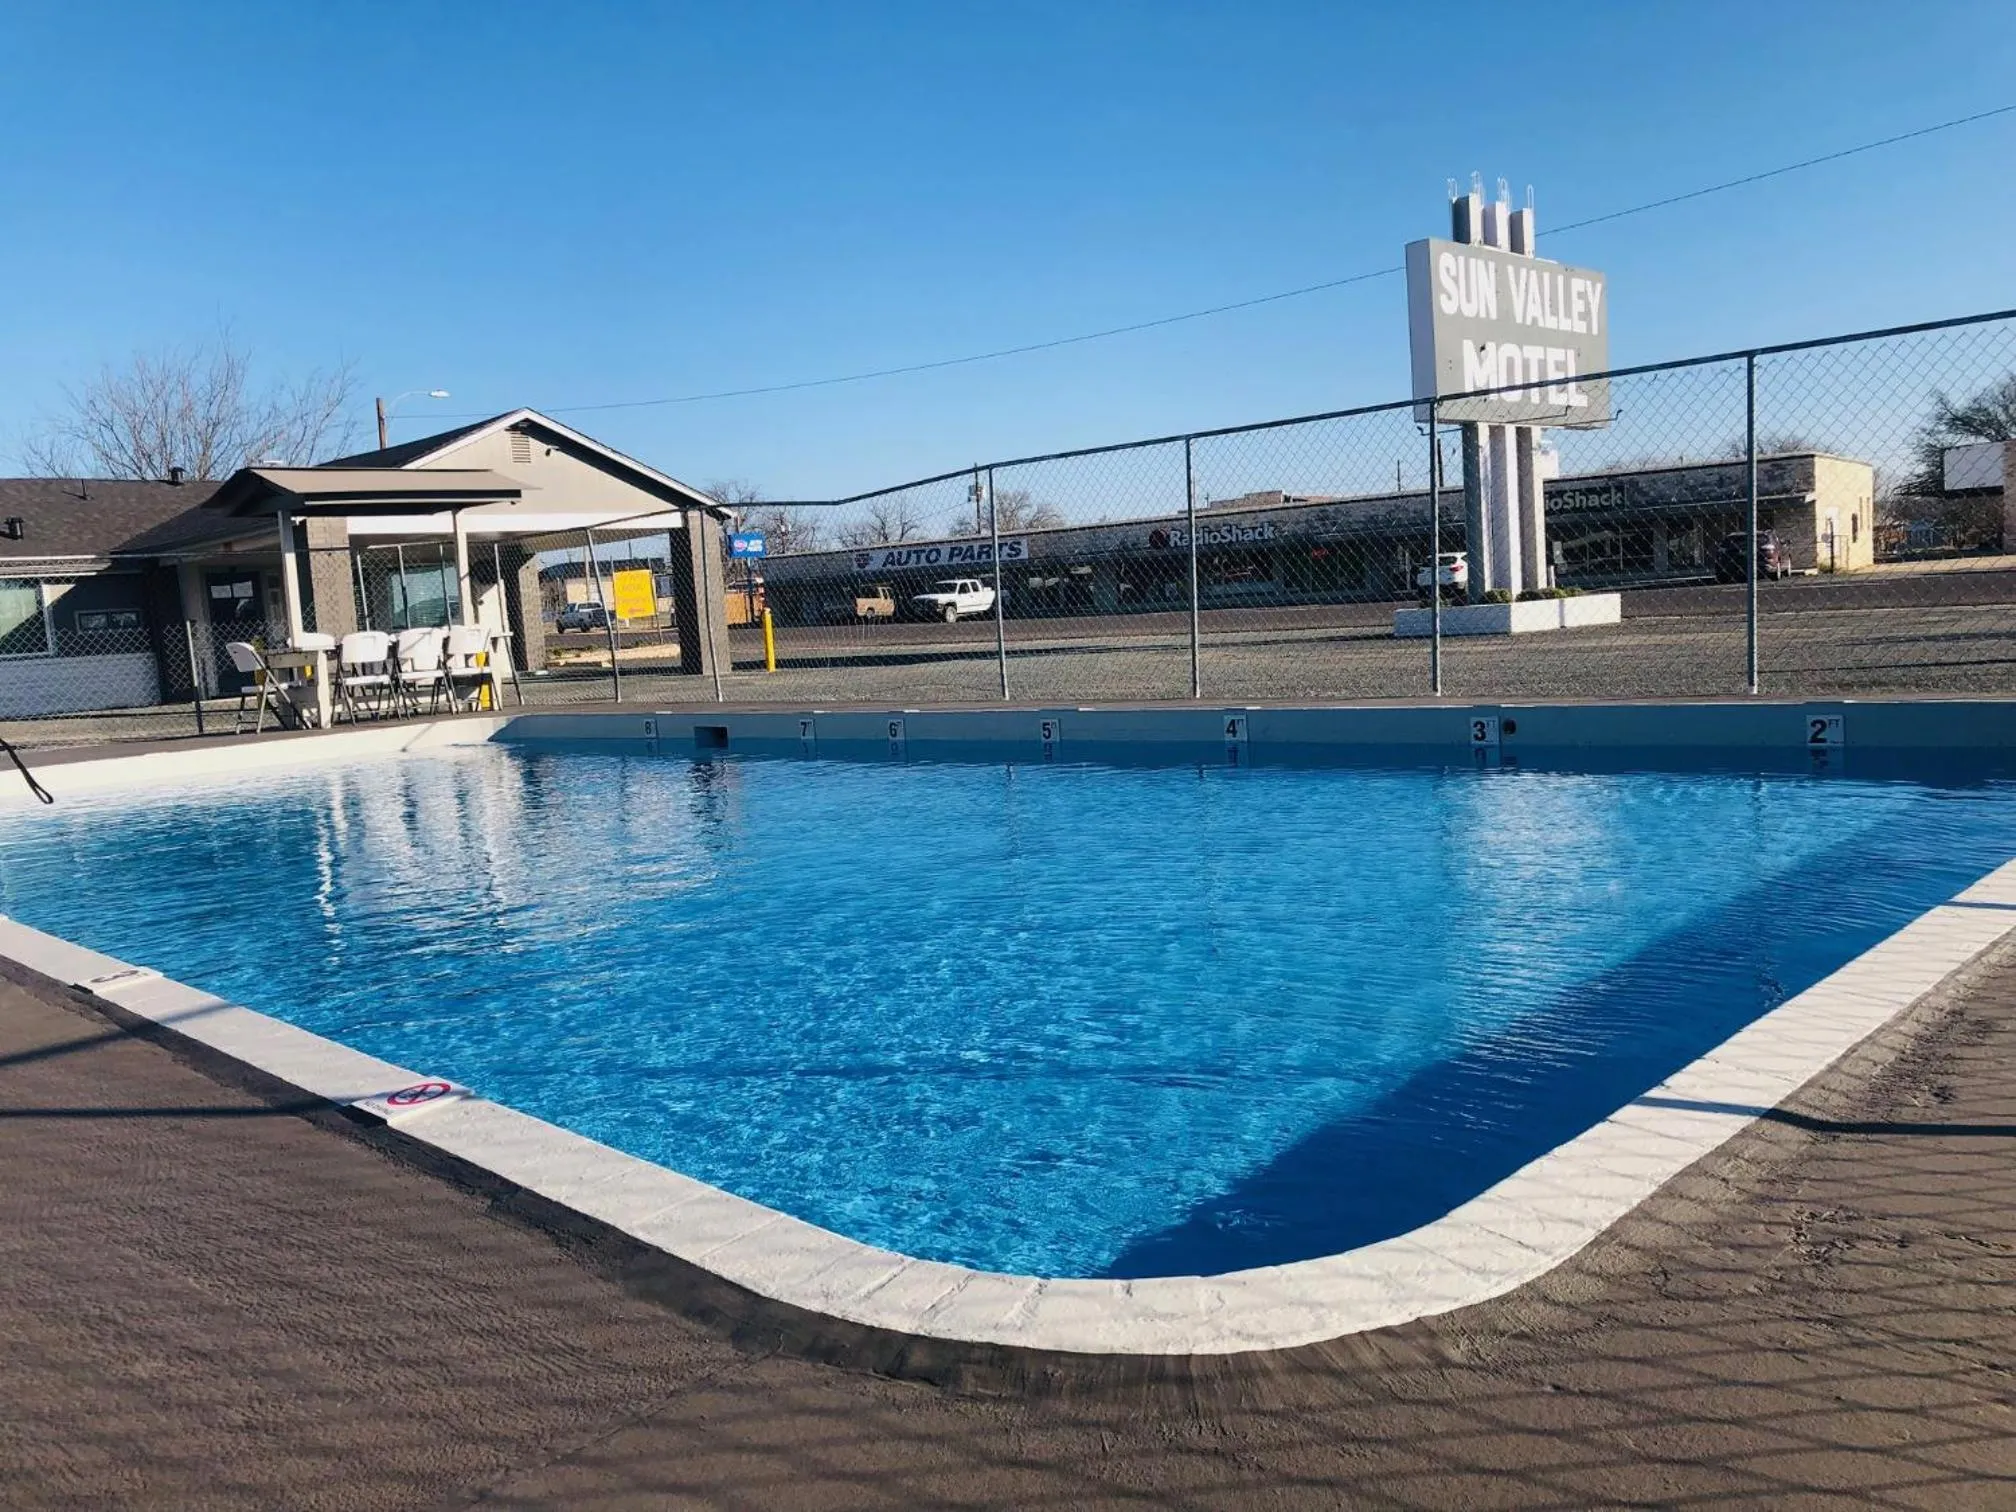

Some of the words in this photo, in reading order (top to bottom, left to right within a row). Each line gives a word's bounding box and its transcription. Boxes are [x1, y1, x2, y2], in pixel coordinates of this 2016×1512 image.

[1439, 252, 1497, 319] SUN
[1507, 265, 1602, 335] VALLEY
[1463, 340, 1587, 407] MOTEL
[1170, 522, 1276, 547] RadioShack
[882, 548, 941, 568] AUTO
[947, 541, 1022, 562] PARTS
[801, 722, 807, 736] 7
[889, 722, 897, 737] 6
[1042, 722, 1051, 739] 5
[1226, 719, 1237, 738] 4
[1473, 720, 1486, 741] 3
[1808, 719, 1827, 743] 2
[1829, 719, 1840, 728] FT
